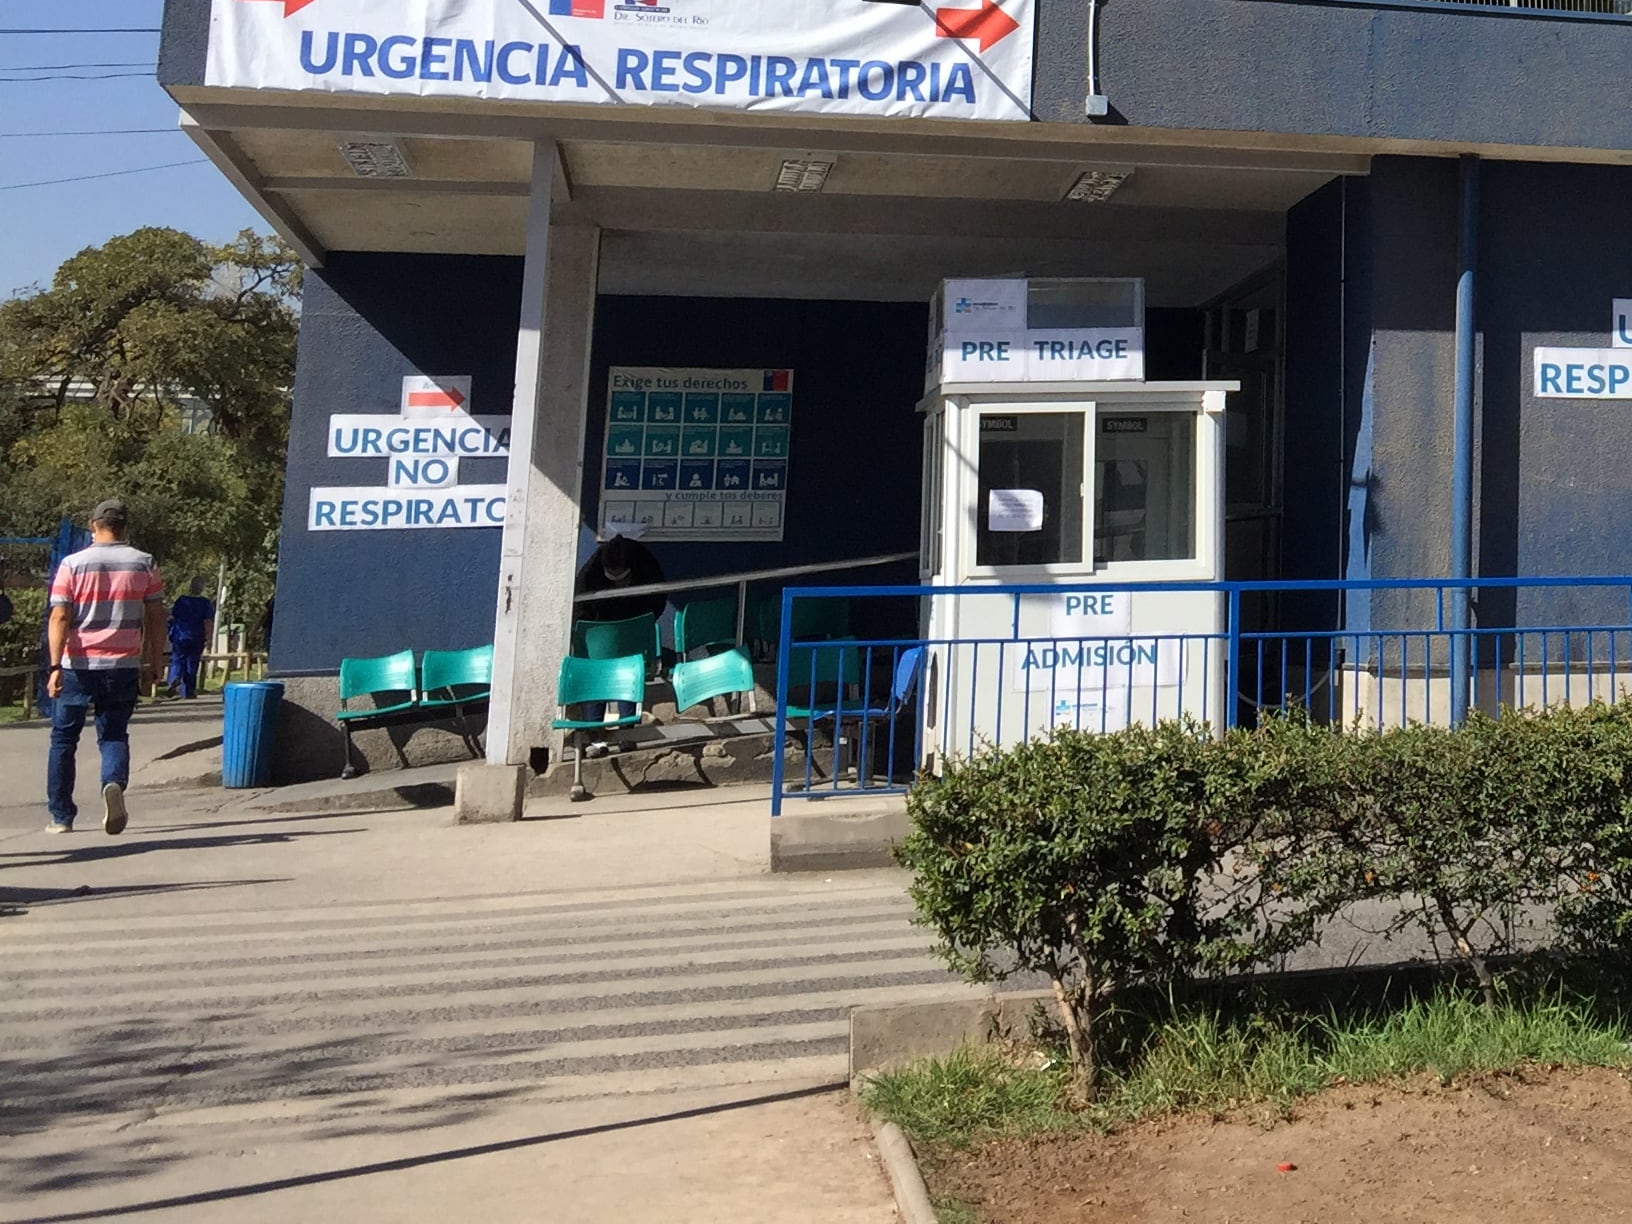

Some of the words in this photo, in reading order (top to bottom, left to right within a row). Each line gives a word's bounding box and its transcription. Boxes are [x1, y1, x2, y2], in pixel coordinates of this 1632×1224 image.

[298, 28, 588, 92] URGENCIA
[615, 46, 977, 106] RESPIRATORIA
[961, 341, 1011, 362] PRE
[1033, 339, 1129, 361] TRIAGE
[613, 375, 652, 391] Exige
[656, 376, 679, 389] tus
[683, 376, 748, 391] derechos
[982, 419, 1014, 430] YMBOL
[1106, 420, 1145, 431] SYMBOL
[335, 426, 511, 454] URGENCIA
[394, 458, 450, 486] NO
[665, 492, 672, 502] y
[675, 491, 717, 502] cumple
[739, 490, 783, 501] deberes
[314, 497, 507, 527] RESPIRATO
[1066, 594, 1114, 616] PRE
[1021, 640, 1157, 671] ADMISIÓN
